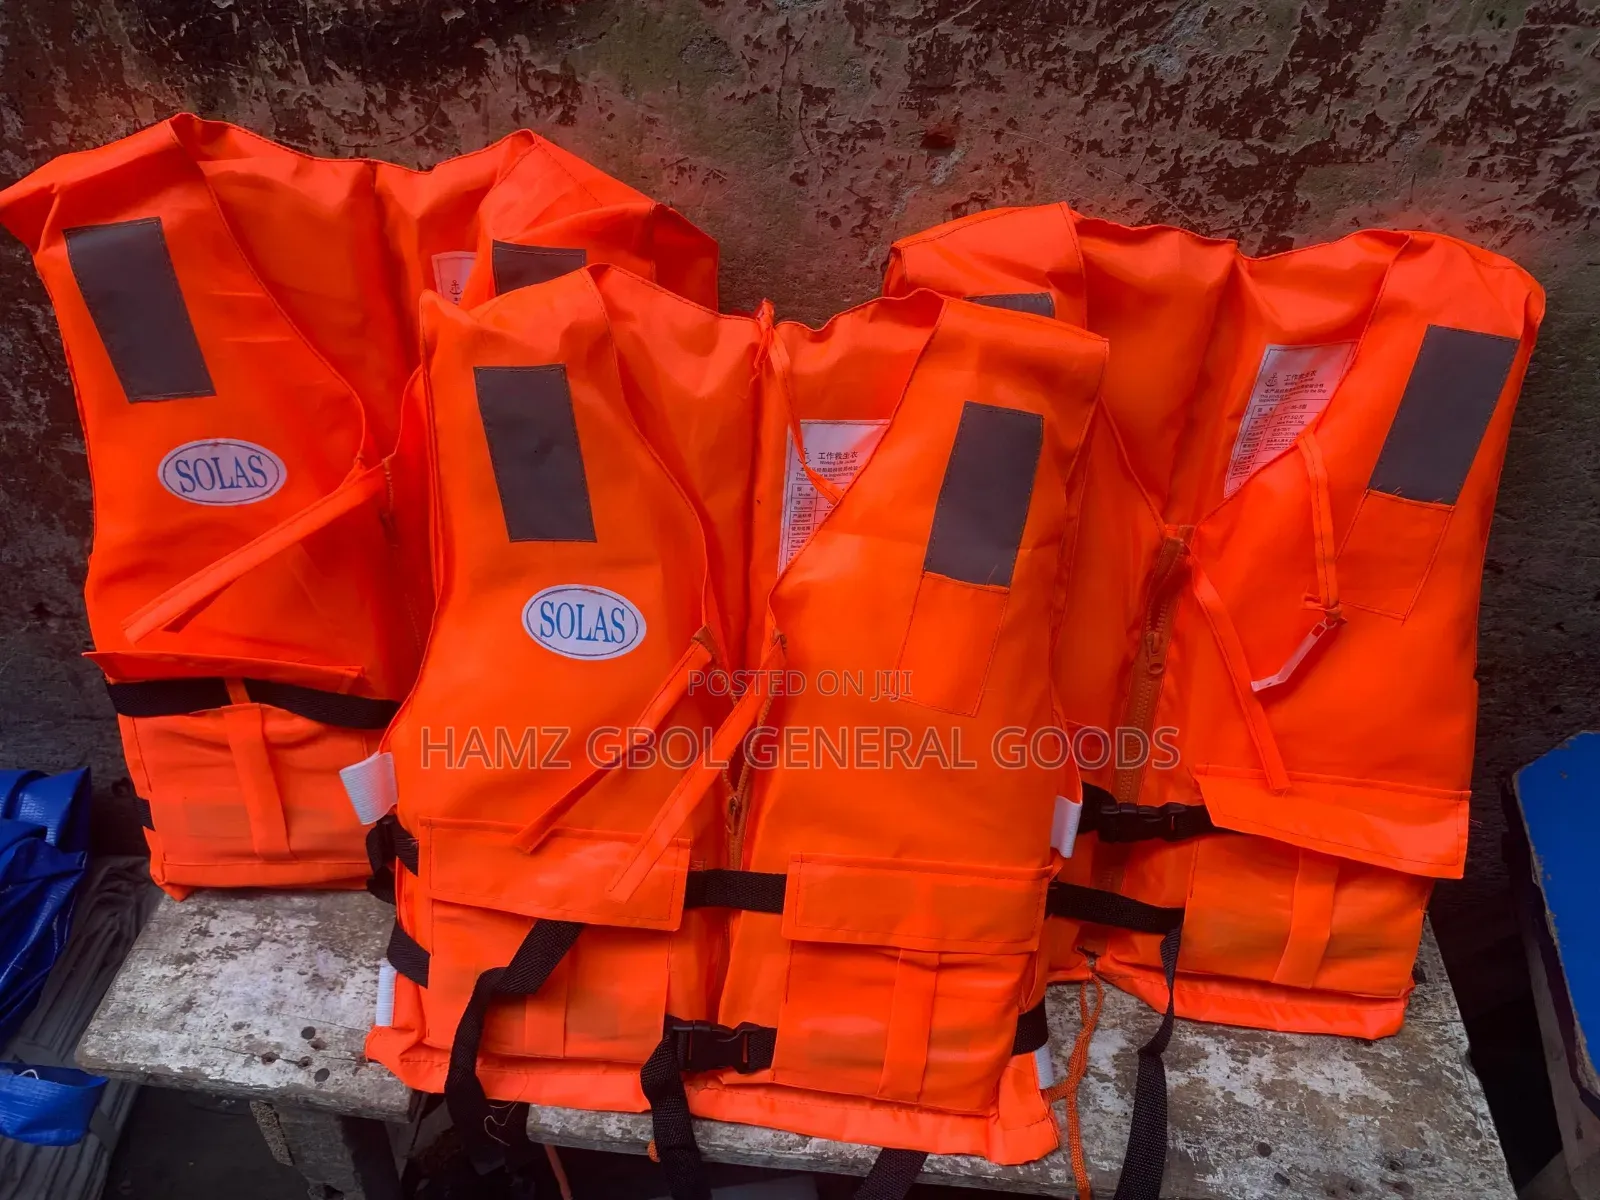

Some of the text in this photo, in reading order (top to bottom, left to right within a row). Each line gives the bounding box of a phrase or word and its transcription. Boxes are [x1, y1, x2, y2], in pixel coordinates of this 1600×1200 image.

[175, 454, 268, 493] SOLAS
[817, 451, 859, 460] 工作救生衣
[540, 600, 626, 644] SOLAS
